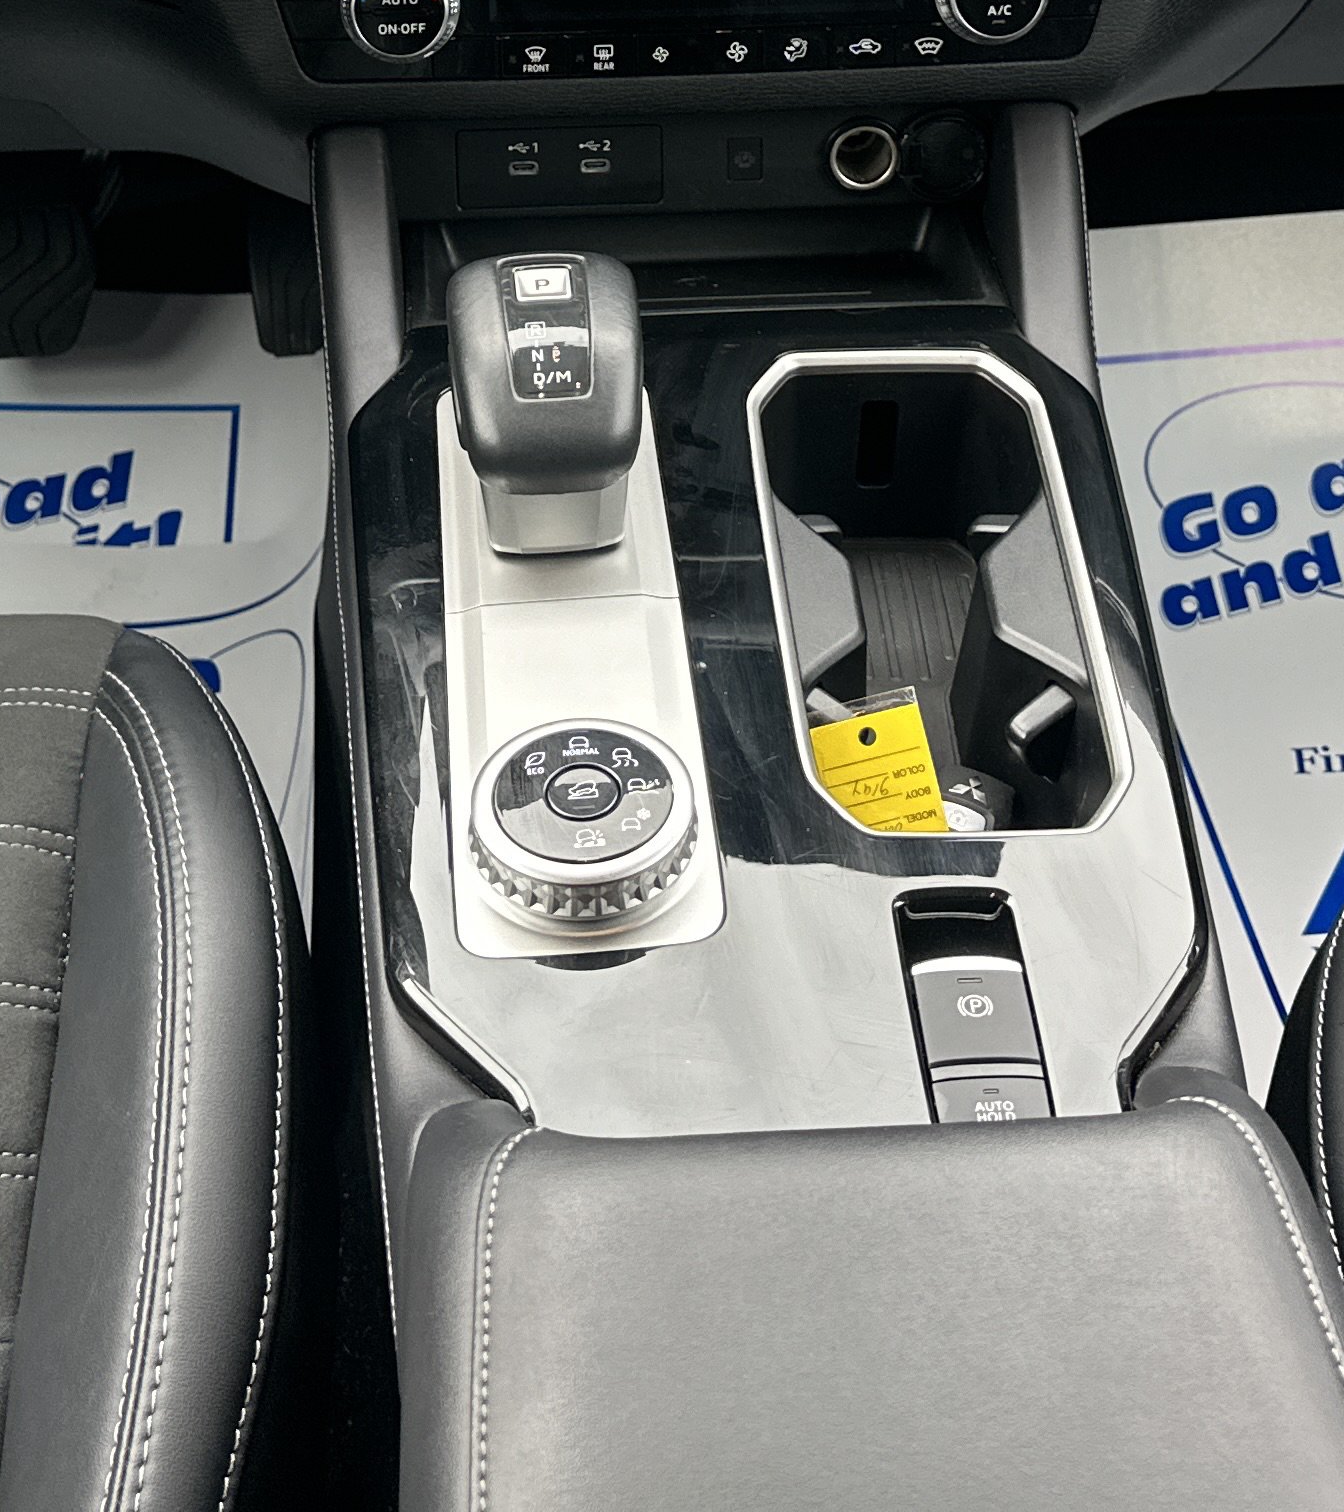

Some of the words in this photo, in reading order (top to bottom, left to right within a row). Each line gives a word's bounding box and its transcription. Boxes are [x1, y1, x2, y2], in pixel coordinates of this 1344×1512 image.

[987, 3, 1013, 18] A/C
[523, 63, 550, 74] FRONT
[593, 61, 615, 72] REAR
[531, 141, 539, 154] 1
[602, 139, 611, 152] 2
[534, 278, 550, 291] P
[529, 323, 543, 337] R
[531, 348, 545, 363] N
[533, 370, 573, 386] D/M
[1157, 483, 1280, 557] Go
[1158, 530, 1343, 629] and
[562, 747, 599, 757] NORMAL
[526, 766, 545, 776] ECO
[892, 764, 926, 780] COLOR
[905, 785, 932, 800] BODY
[906, 808, 938, 824] MODEL
[974, 1100, 1015, 1113] AUTO
